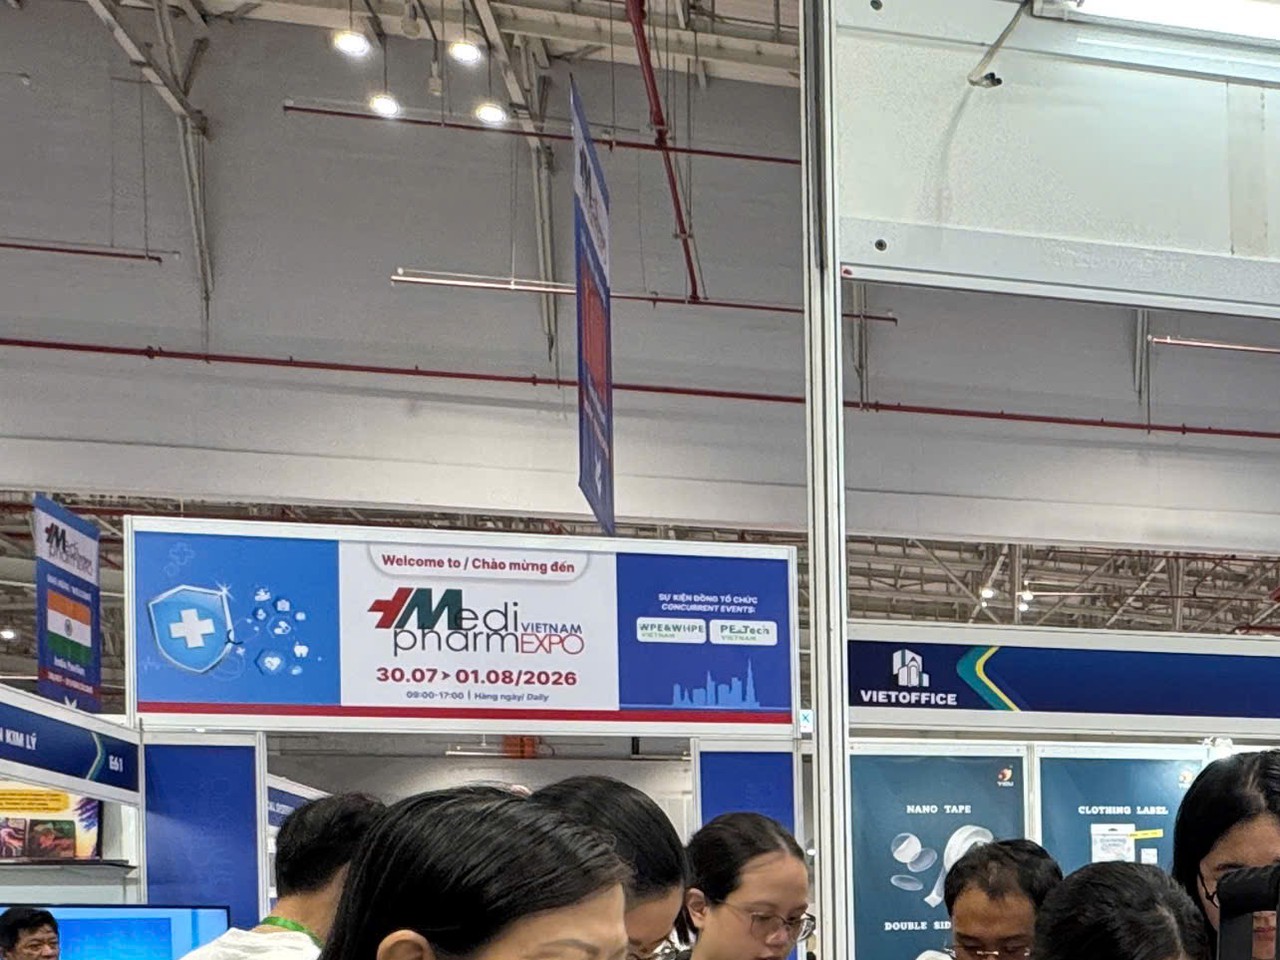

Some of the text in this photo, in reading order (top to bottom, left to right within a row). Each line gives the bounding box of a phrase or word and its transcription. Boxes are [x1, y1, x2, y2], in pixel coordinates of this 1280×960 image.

[382, 554, 444, 568] Welcome
[448, 557, 460, 568] to
[472, 558, 505, 570] Chào
[509, 560, 547, 574] mừng
[550, 560, 575, 573] đến
[395, 588, 519, 631] Medi
[661, 603, 719, 612] CONCURRENT
[521, 623, 582, 634] VIETNAM
[376, 668, 577, 686] 30.07 01.08/2026
[860, 690, 957, 706] VIETOFFICE
[5, 729, 36, 750] KIM LÝ
[109, 755, 123, 772] E61
[906, 805, 971, 813] NANO TAPE
[1078, 806, 1169, 814] CLOTHING LABEL
[884, 921, 951, 931] DOUBLE SID
